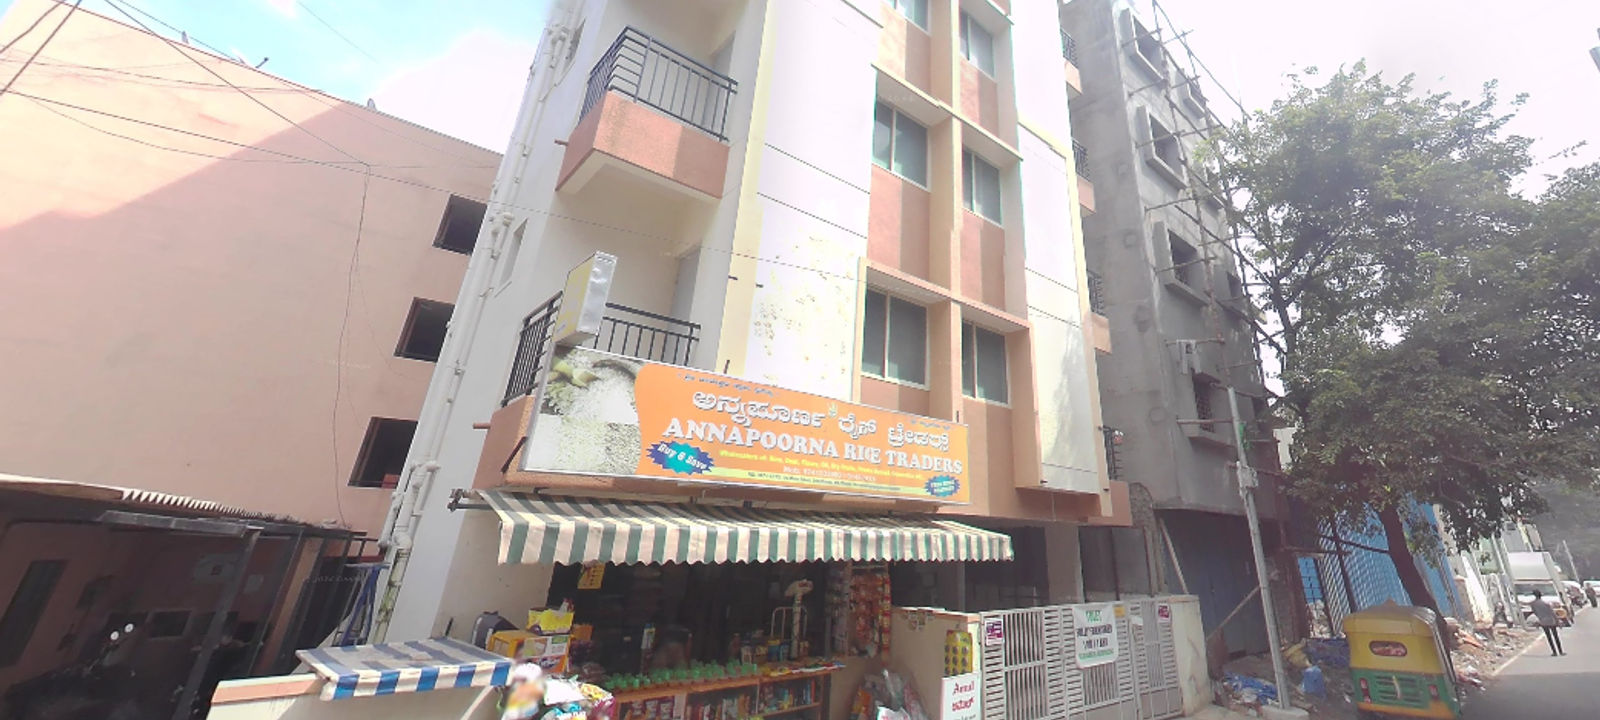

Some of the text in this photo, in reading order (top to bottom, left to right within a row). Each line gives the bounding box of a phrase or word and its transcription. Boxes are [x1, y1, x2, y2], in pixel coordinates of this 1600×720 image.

[657, 443, 677, 458] Buy
[686, 455, 707, 470] Save
[662, 417, 839, 459] ANNAPOORNA
[885, 449, 963, 474] TRADERS
